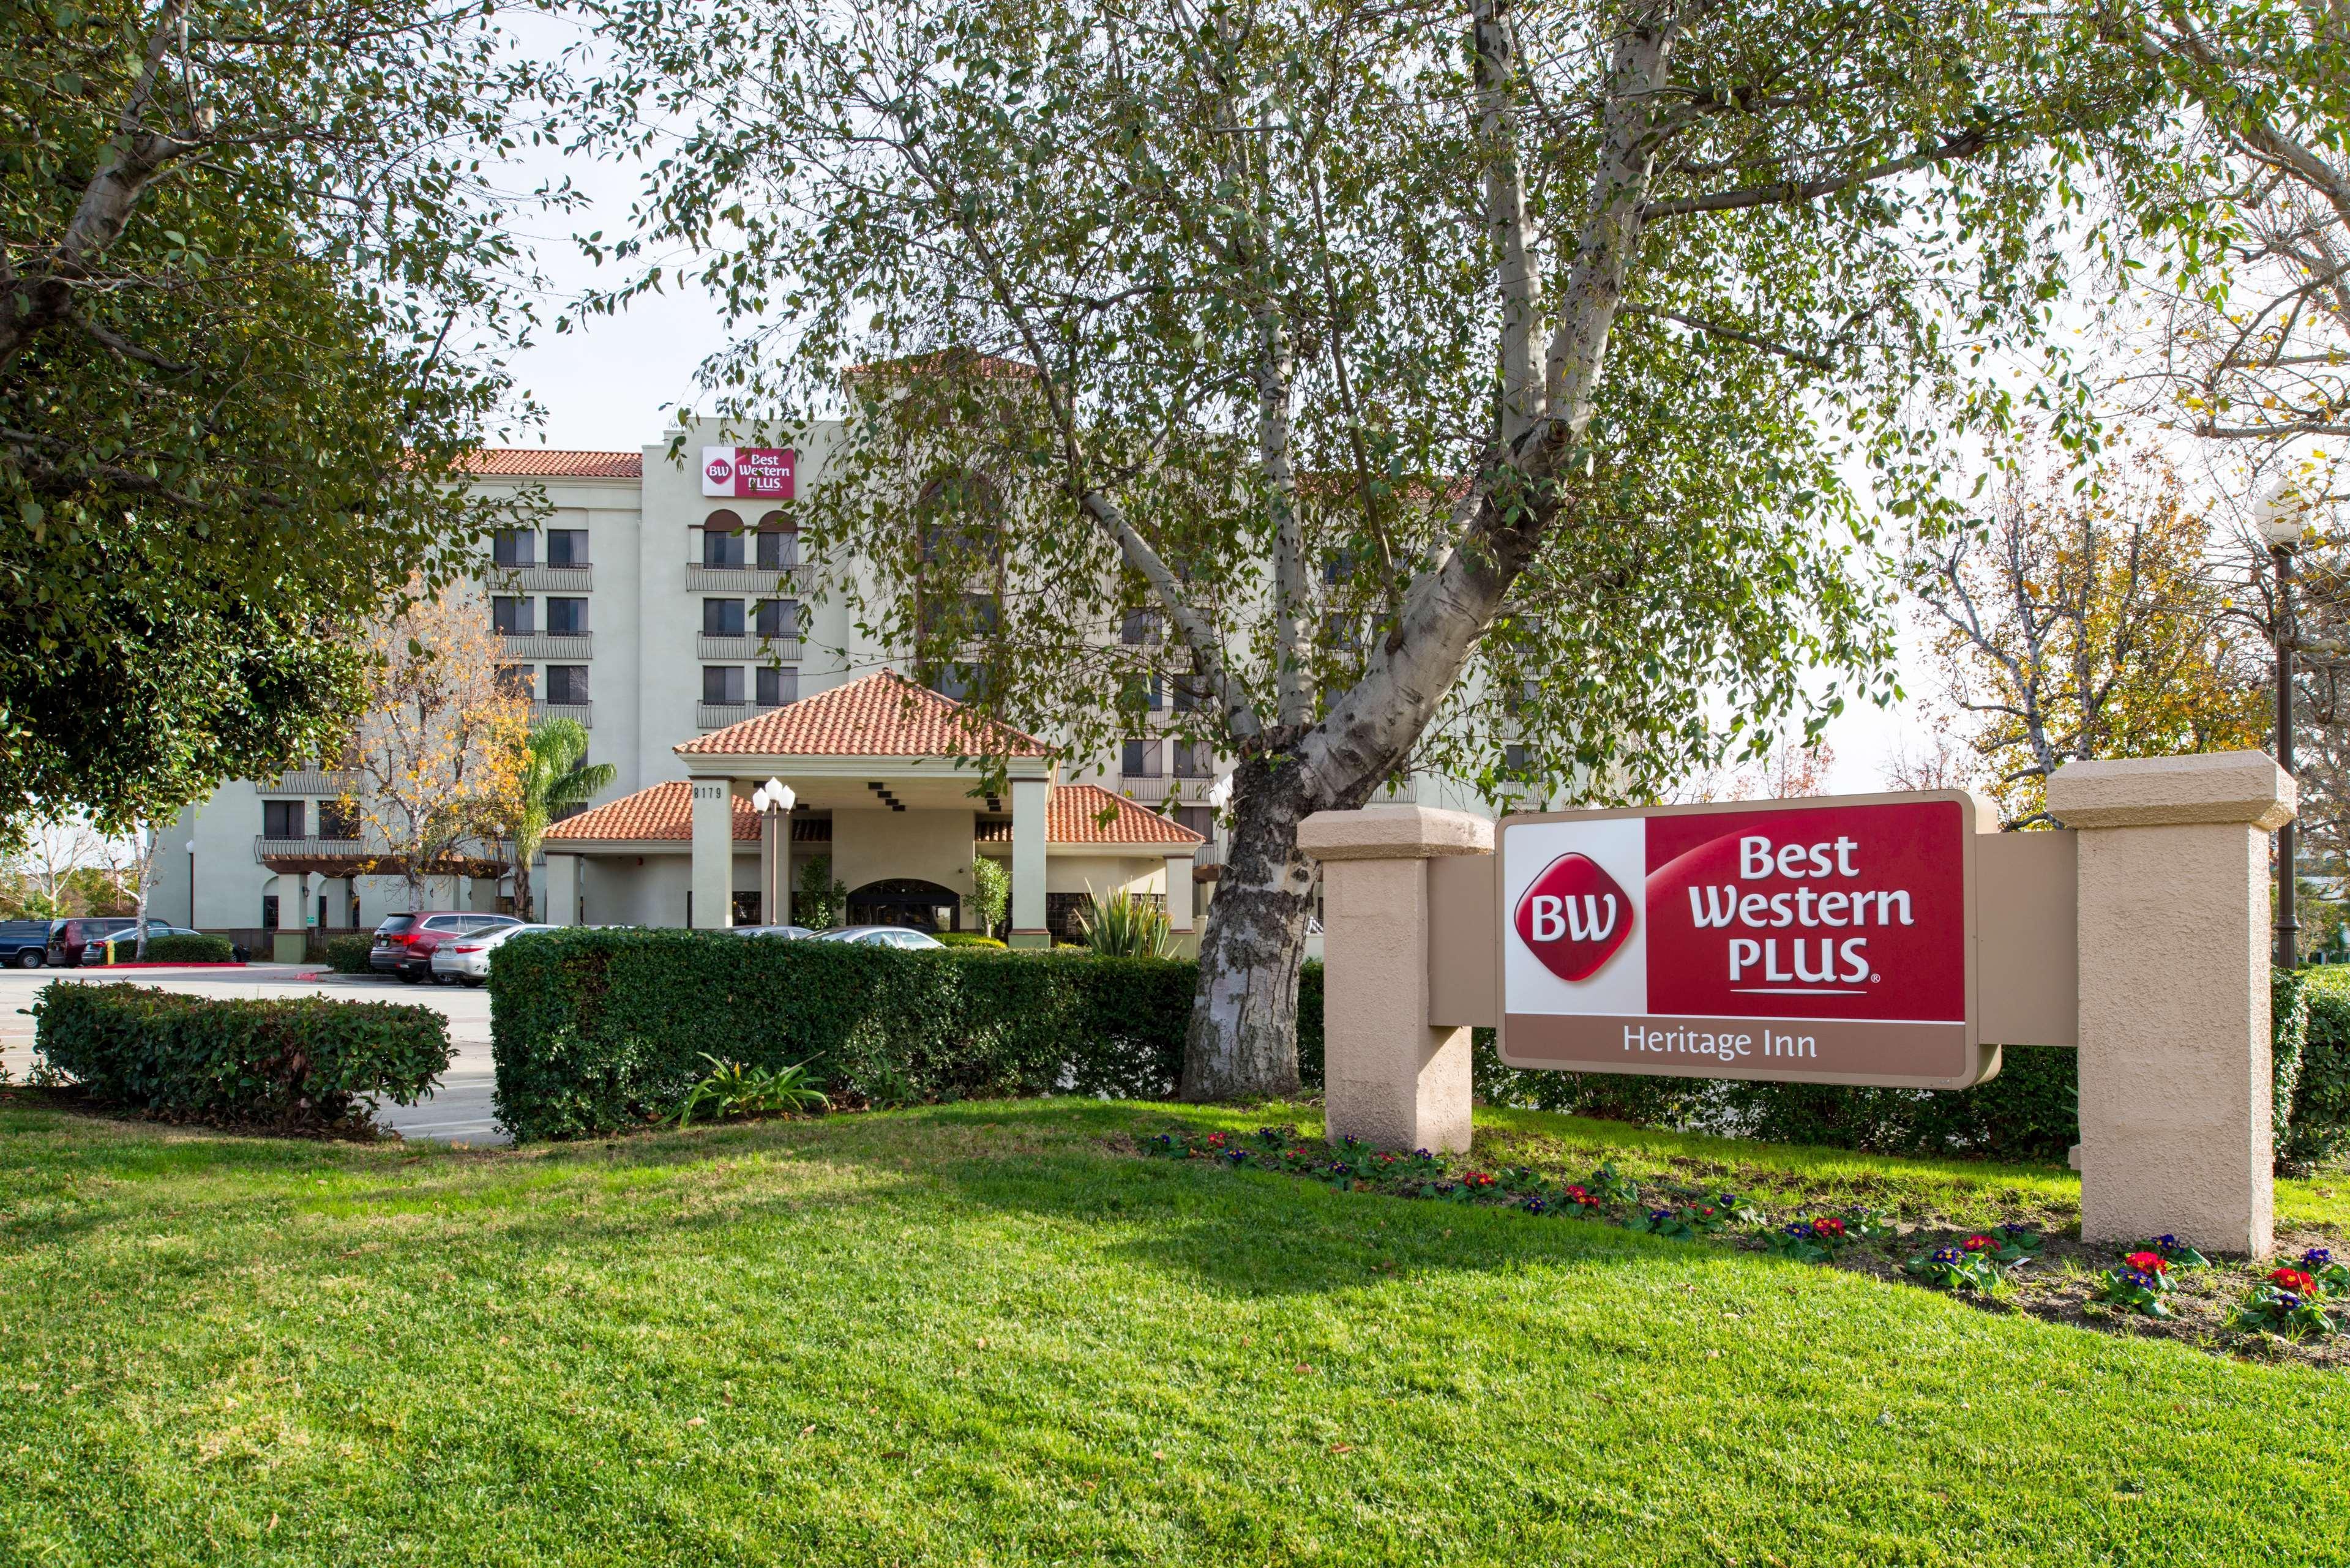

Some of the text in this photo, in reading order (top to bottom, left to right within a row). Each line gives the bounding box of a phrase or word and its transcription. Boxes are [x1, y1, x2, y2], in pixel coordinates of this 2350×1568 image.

[709, 466, 728, 476] BW
[739, 465, 790, 476] Western
[751, 454, 779, 465] Best
[694, 787, 721, 799] 8179
[1740, 835, 1859, 879] Best
[1532, 894, 1617, 943] BW
[1688, 885, 1914, 928] Western
[1623, 1025, 1818, 1062] Heritage Inn
